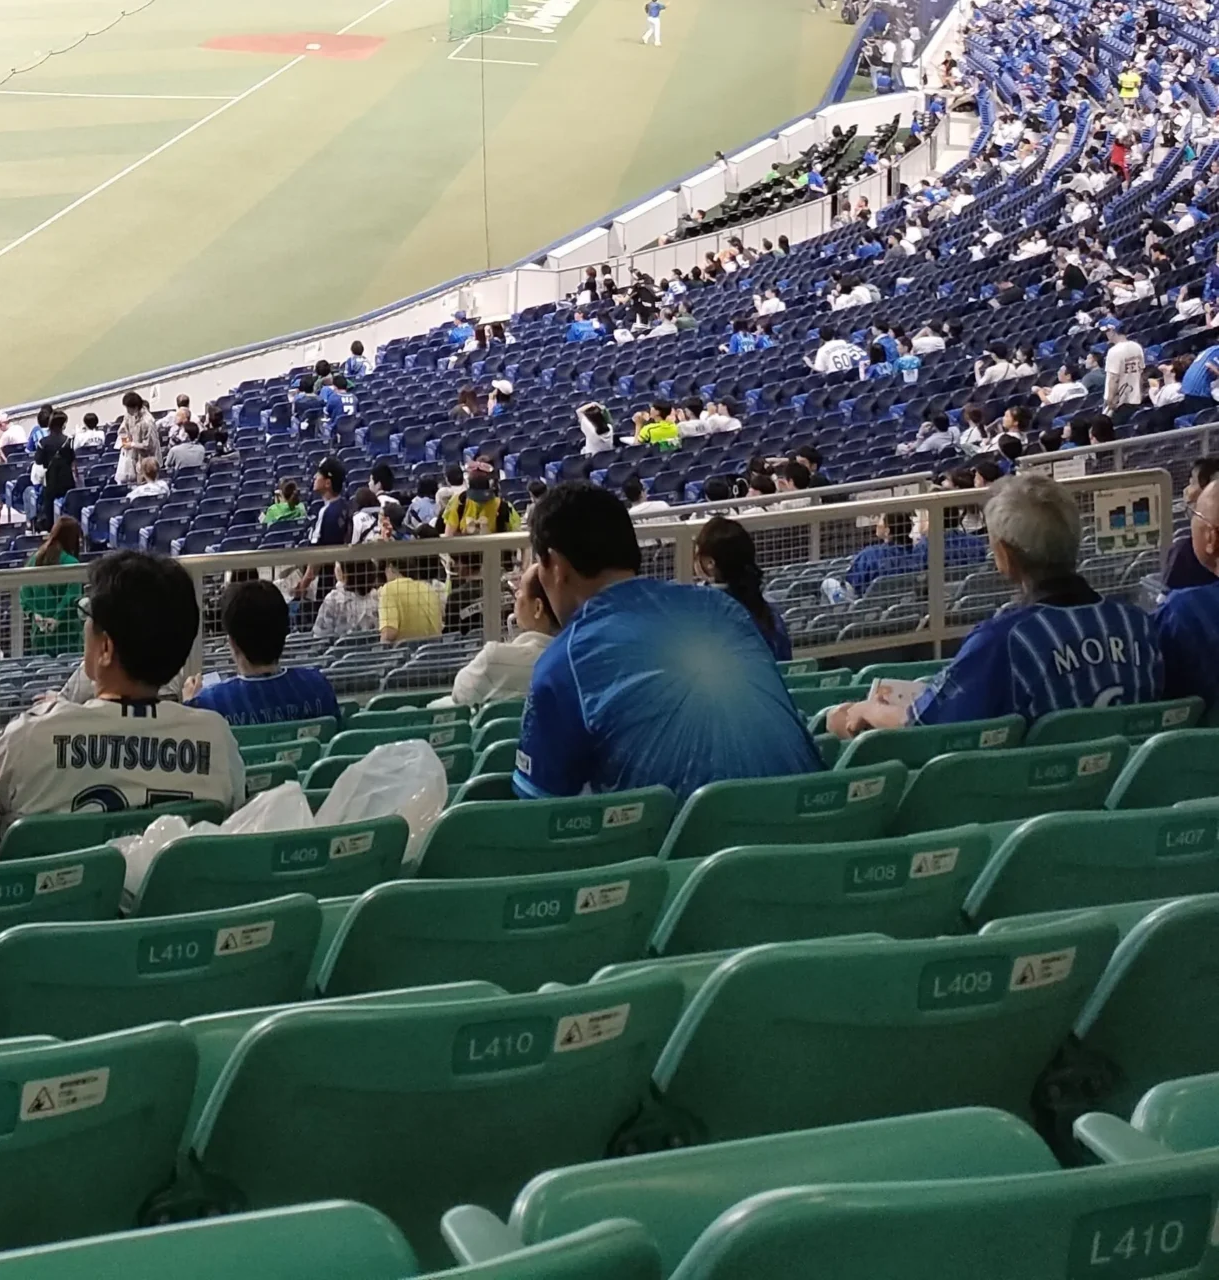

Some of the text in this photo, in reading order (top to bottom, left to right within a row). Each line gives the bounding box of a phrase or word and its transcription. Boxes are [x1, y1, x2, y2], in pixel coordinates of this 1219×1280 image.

[1053, 636, 1141, 675] MORI
[53, 735, 211, 776] TSUTSUGOH
[1166, 828, 1205, 847] L407
[281, 848, 318, 864] L409
[853, 864, 896, 883] L408
[515, 898, 561, 918] L409
[149, 941, 199, 962] L410
[934, 972, 991, 997] L409
[469, 1032, 534, 1061] L410
[1091, 1223, 1181, 1264] L410
